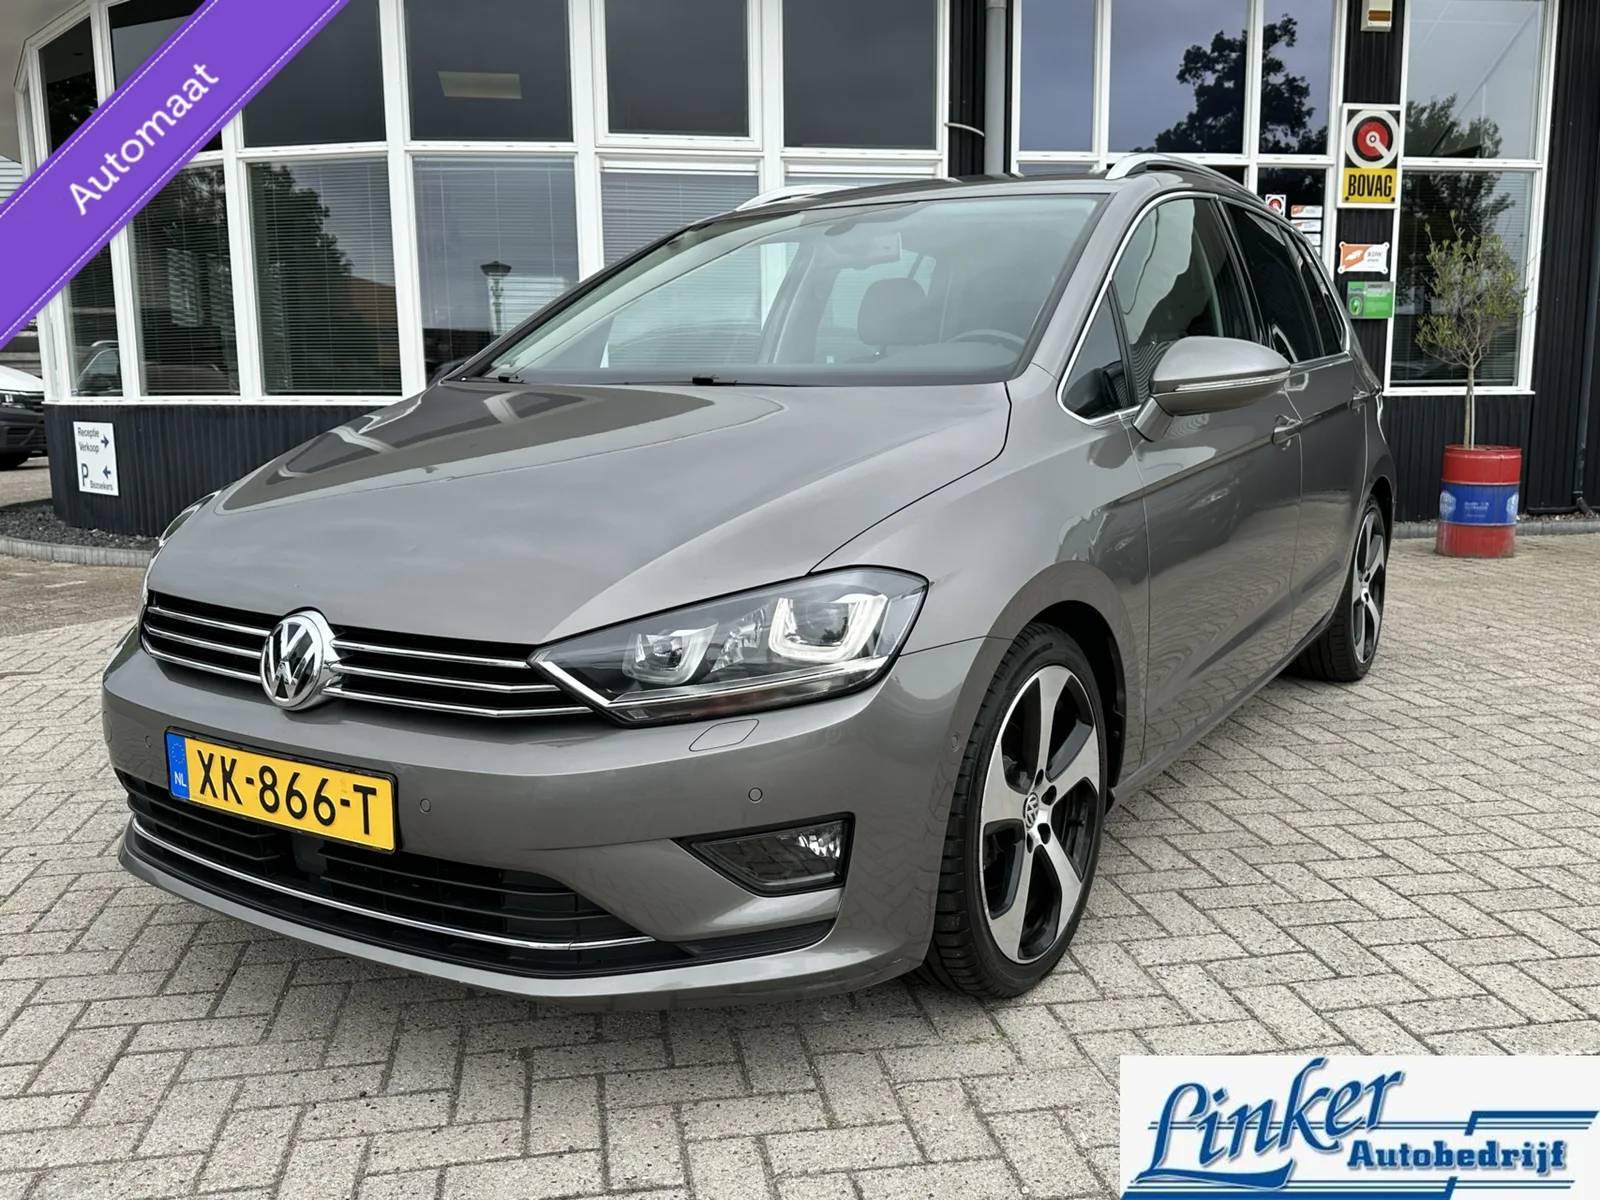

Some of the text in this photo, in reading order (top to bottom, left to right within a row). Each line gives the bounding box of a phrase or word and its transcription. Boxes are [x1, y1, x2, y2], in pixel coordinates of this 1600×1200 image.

[1348, 173, 1393, 198] BOVAG
[77, 427, 100, 439] Receptie
[79, 442, 100, 454] Verkoop
[81, 463, 89, 487] P
[90, 480, 114, 491] Bezoekers
[174, 771, 188, 788] NL
[196, 749, 378, 836] XK-866-T
